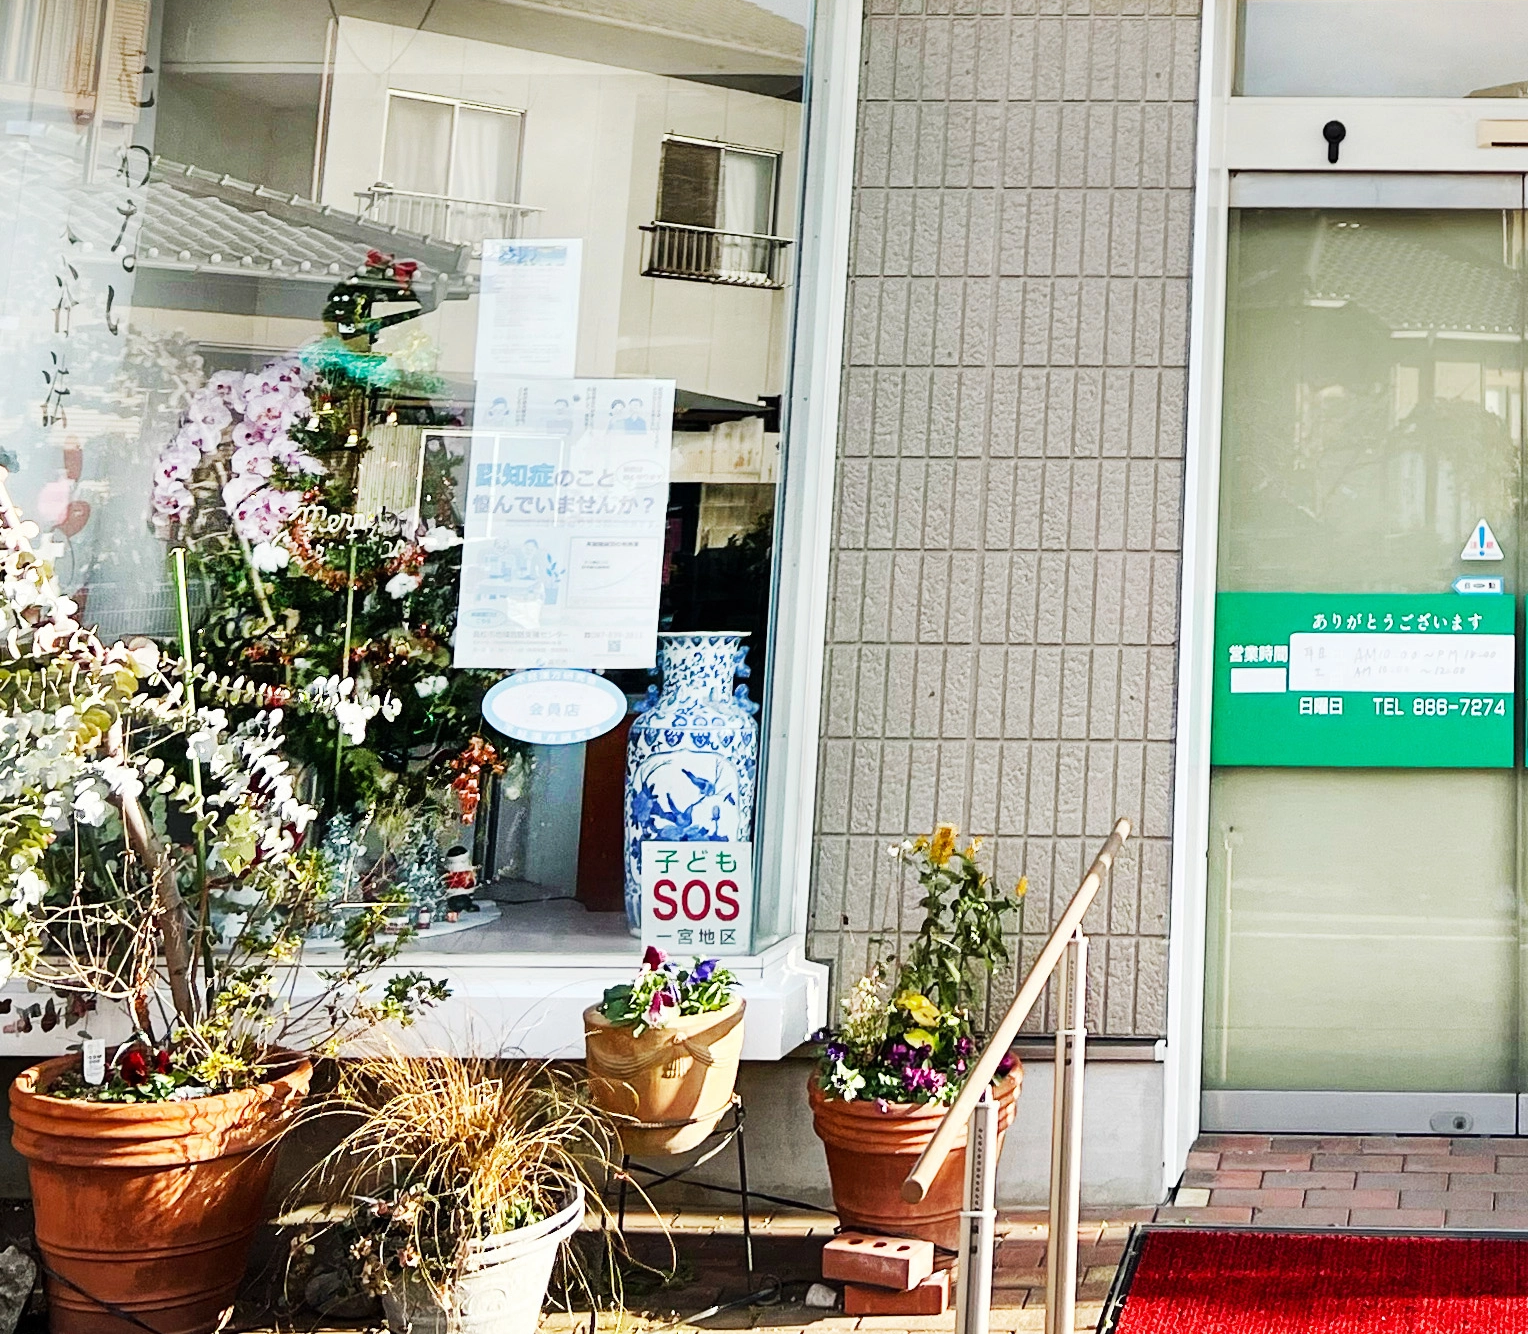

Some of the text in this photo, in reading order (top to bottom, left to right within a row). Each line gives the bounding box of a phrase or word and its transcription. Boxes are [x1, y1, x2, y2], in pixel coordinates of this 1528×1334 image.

[1312, 613, 1483, 632] ありがとうございます
[1228, 644, 1288, 664] 営業時間
[1372, 697, 1405, 716] TEL
[1412, 698, 1506, 717] 886-7274
[654, 849, 737, 874] 子ども
[652, 878, 740, 922] SOS
[656, 928, 737, 945] 一宮地区
